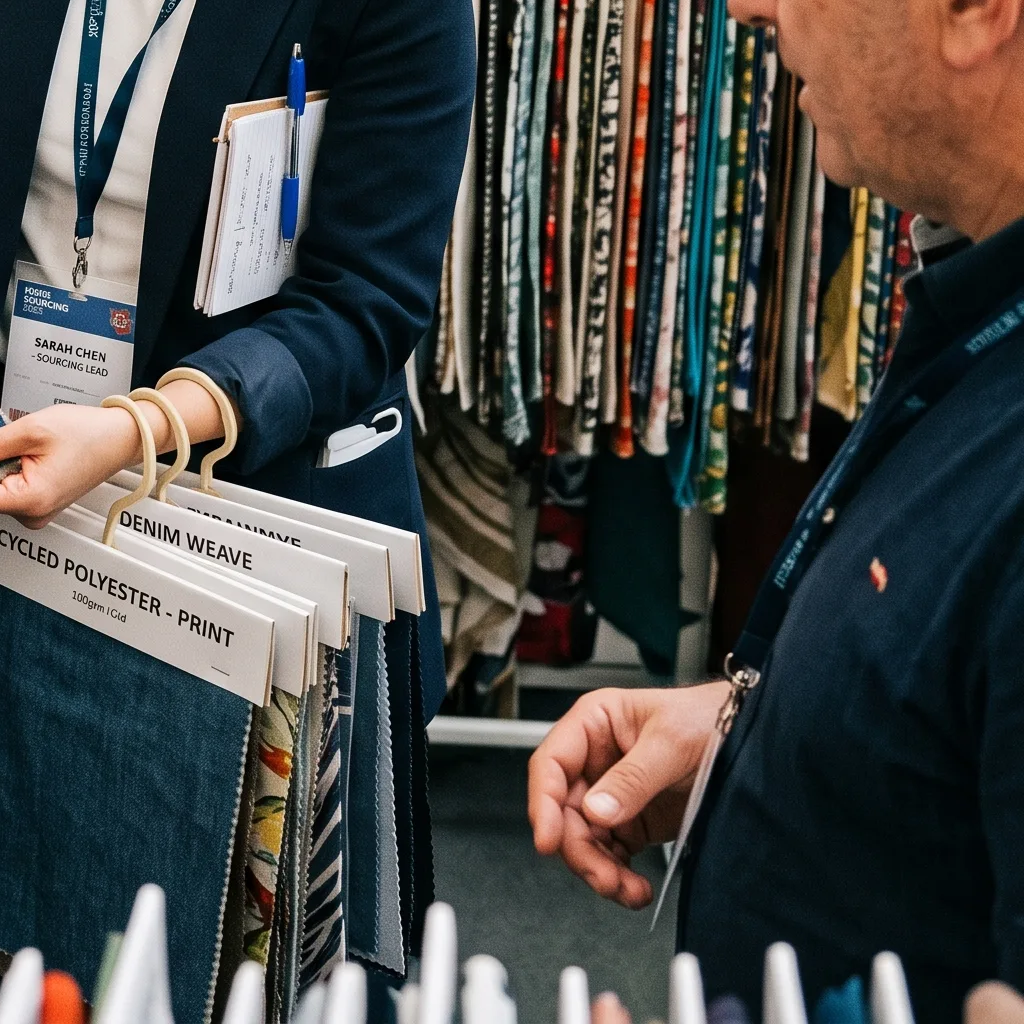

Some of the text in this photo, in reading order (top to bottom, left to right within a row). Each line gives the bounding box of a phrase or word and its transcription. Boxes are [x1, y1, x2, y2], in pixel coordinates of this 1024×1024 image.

[24, 295, 69, 312] SOURCING
[35, 338, 106, 362] SARAH CHEN
[36, 353, 84, 371] SOURCING
[86, 364, 109, 377] LEAD
[119, 511, 180, 546] DENIM
[186, 532, 252, 570] WEAVE
[64, 558, 161, 617] POLYESTER
[178, 609, 235, 648] PRINT
